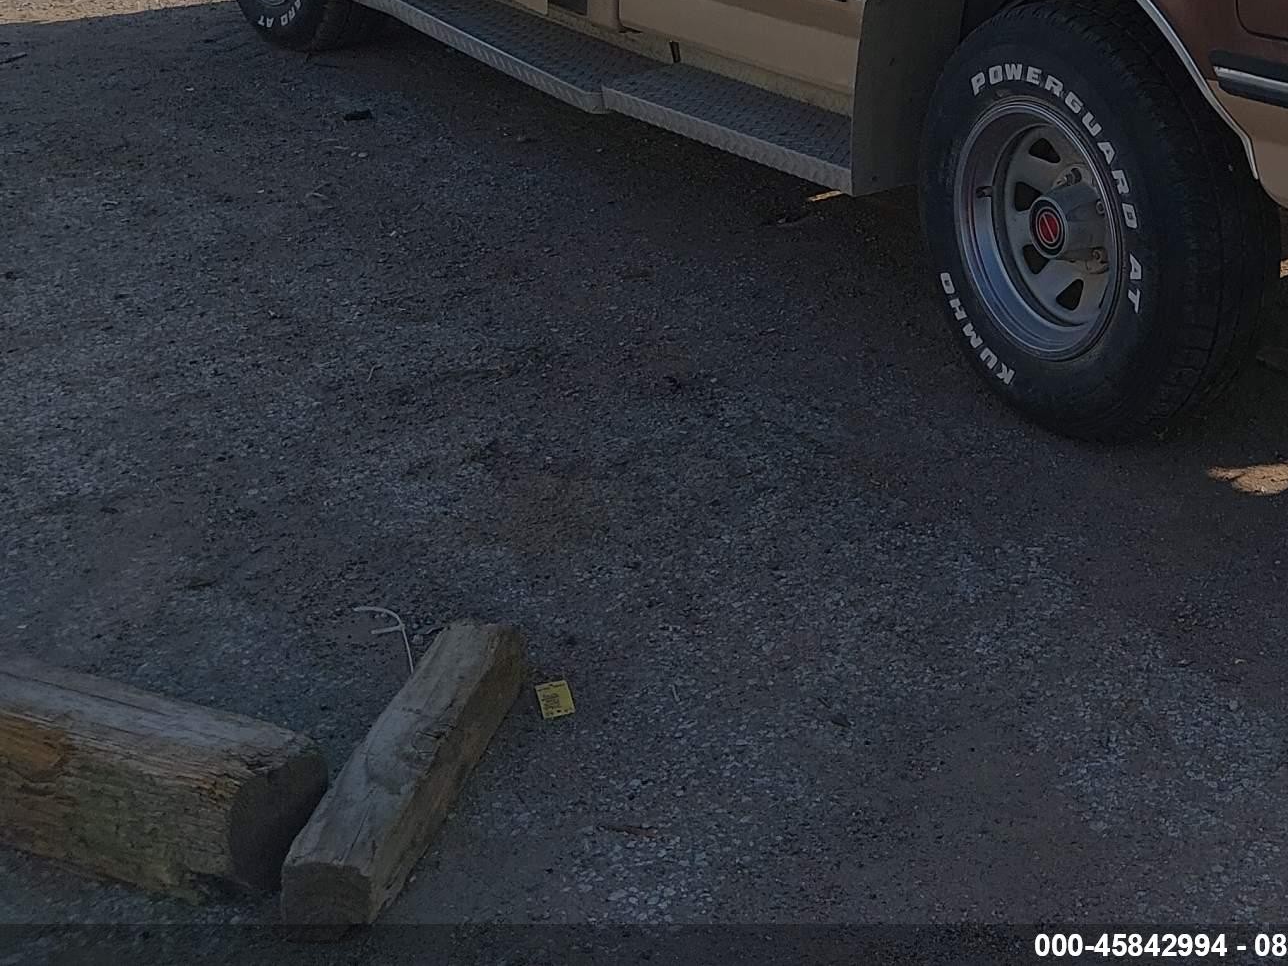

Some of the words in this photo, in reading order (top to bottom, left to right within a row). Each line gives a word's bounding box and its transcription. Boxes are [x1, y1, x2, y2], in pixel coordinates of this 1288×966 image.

[970, 63, 1138, 229] POWERGUARD
[1127, 253, 1142, 313] AT
[939, 272, 1016, 386] KUMHO
